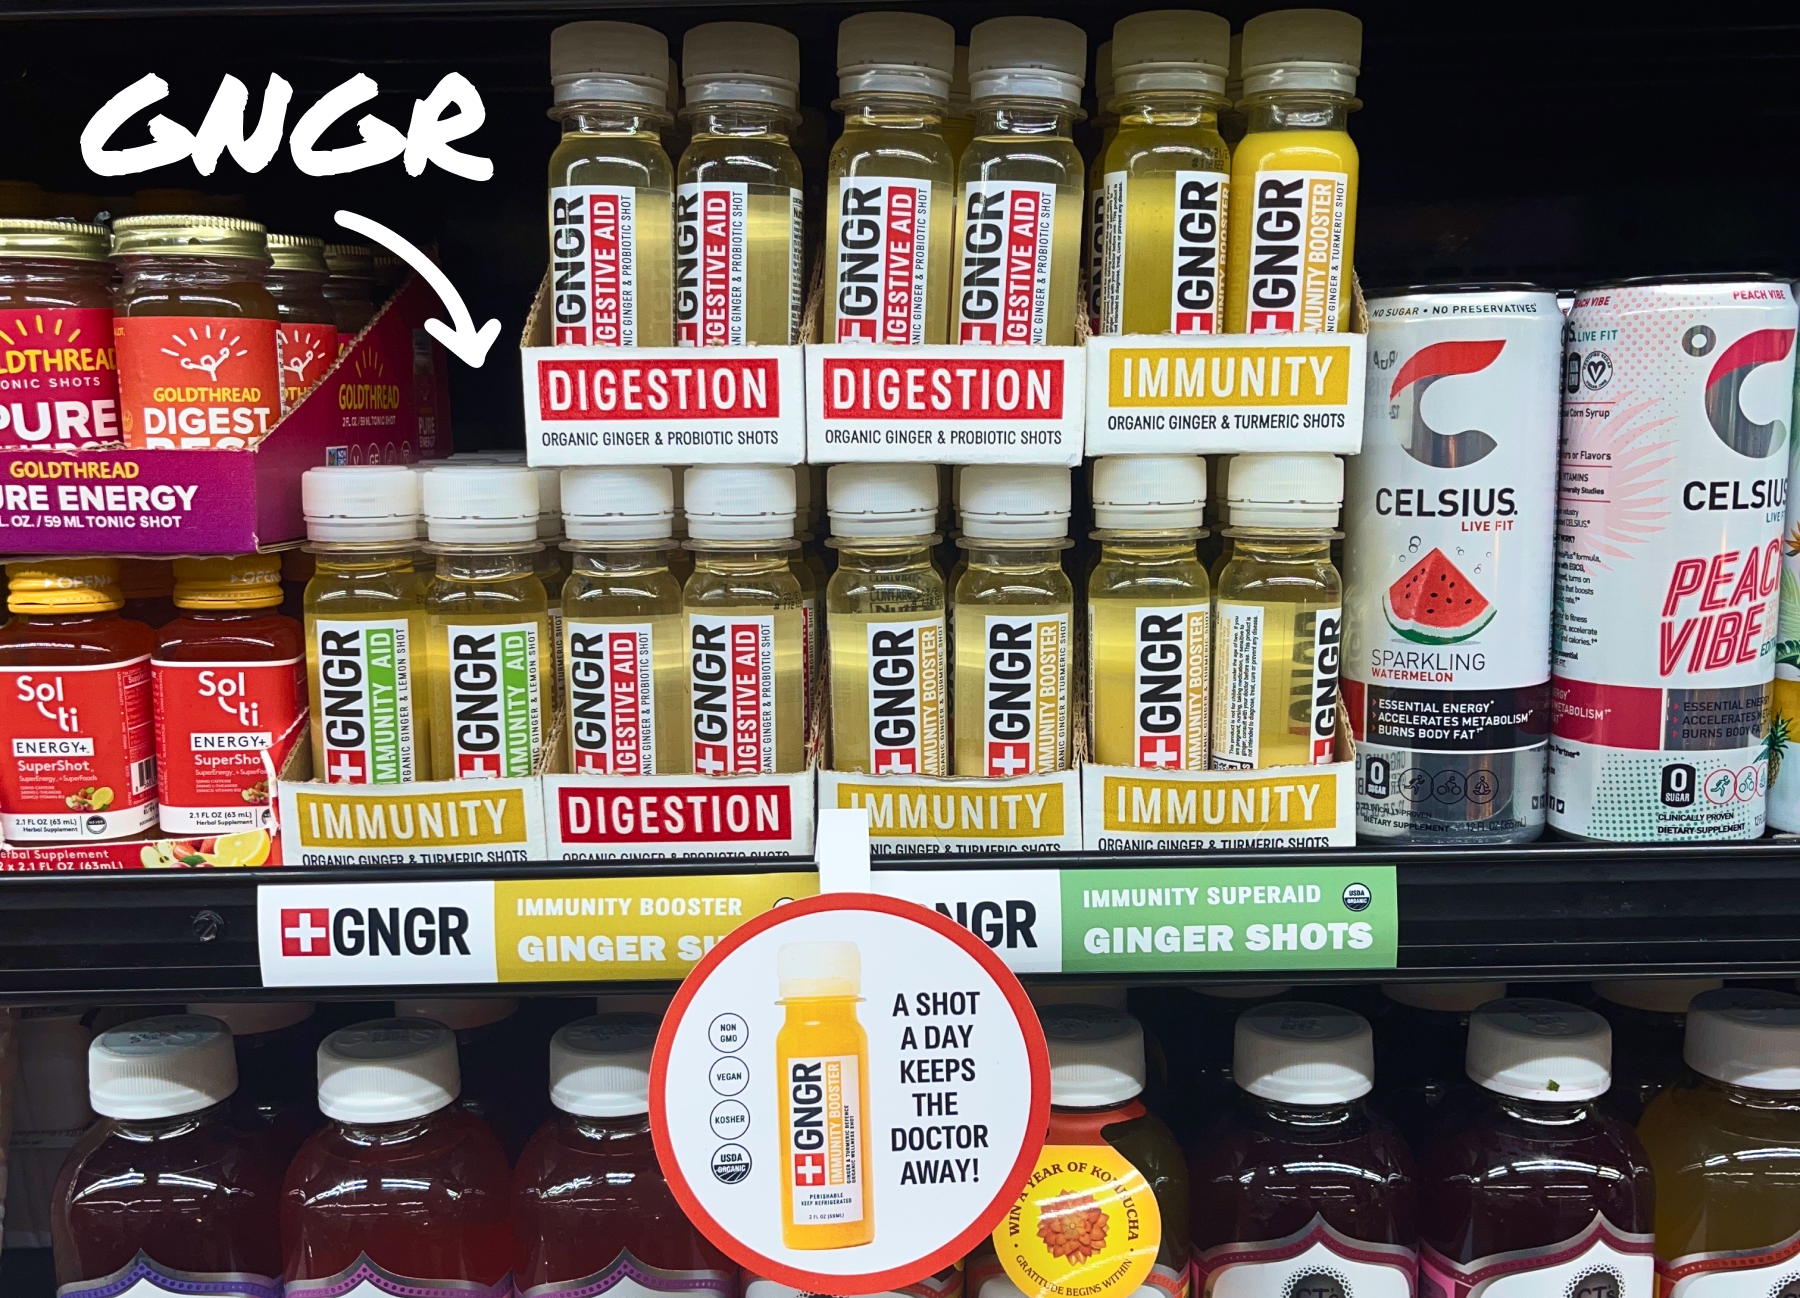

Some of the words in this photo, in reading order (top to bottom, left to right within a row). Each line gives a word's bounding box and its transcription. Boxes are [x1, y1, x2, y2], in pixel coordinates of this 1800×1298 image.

[890, 194, 912, 234] AID
[918, 188, 927, 216] SHOT
[1013, 197, 1036, 237] AID
[1309, 184, 1332, 262] BOOSTER
[839, 187, 882, 316] GNGR
[916, 218, 926, 272] PROBIOTIC
[961, 191, 1005, 320] GNGR
[1176, 180, 1219, 310] GNGR
[1252, 178, 1304, 309] GNGR
[554, 195, 586, 324] GNGR
[913, 284, 923, 324] GINGER
[1733, 290, 1767, 300] PEACH
[1768, 290, 1786, 299] VIBE
[1386, 308, 1419, 316] SUGAR
[1432, 306, 1448, 314] NO
[1577, 332, 1596, 342] LIVE
[1600, 330, 1618, 341] FIT
[49, 377, 100, 388] SHOTS
[548, 368, 767, 411] DIGESTION
[833, 368, 1051, 411] DIGESTION
[1123, 356, 1333, 398] IMMUNITY
[154, 387, 261, 402] GOLDTHREAD
[339, 384, 399, 410] GOLDTHREAD
[143, 407, 270, 434] DIGEST
[1108, 415, 1165, 430] ORGANIC
[1168, 415, 1217, 430] GINGER
[1221, 415, 1230, 429] &
[1234, 414, 1299, 429] TURMERIC
[1303, 413, 1345, 428] SHOTS
[1586, 408, 1610, 419] Syrup
[542, 432, 598, 447] ORGANIC
[603, 432, 650, 446] GINGER
[655, 432, 663, 445] &
[668, 431, 734, 446] PROBIOTIC
[738, 430, 778, 444] SHOTS
[825, 429, 882, 444] ORGANIC
[886, 430, 932, 444] GINGER
[938, 430, 946, 444] &
[950, 430, 1016, 445] PROBIOTIC
[1020, 430, 1062, 444] SHOTS
[1580, 451, 1611, 460] Flavors
[10, 461, 139, 479] GOLDTHREAD
[58, 485, 199, 510] ENERGY
[11, 516, 34, 527] OZ.
[44, 516, 61, 527] 59
[64, 516, 85, 527] ML
[85, 515, 136, 528] TONIC
[139, 515, 182, 528] SHOT
[1461, 522, 1490, 532] LIVE
[1495, 520, 1513, 531] FIT
[370, 633, 393, 668] AID
[396, 629, 406, 653] SHOT
[1659, 603, 1766, 677] VIBE
[922, 630, 936, 702] BOOSTER
[1140, 613, 1183, 733] GNGR
[1371, 649, 1486, 671] SPARKLING
[397, 658, 407, 691] LEMON
[693, 624, 728, 742] GNGR
[872, 628, 915, 746] GNGR
[988, 622, 1032, 740] GNGR
[1315, 617, 1341, 736] GNGR
[1371, 668, 1453, 682] WATERMELON
[321, 630, 365, 748] GNGR
[453, 633, 500, 752] GNGR
[571, 632, 607, 749] GNGR
[1378, 712, 1458, 726] ACCELERATES
[1379, 699, 1439, 713] ESSENTIAL
[1682, 712, 1756, 725] ACCELERATES
[1684, 701, 1743, 711] ESSENTIAL
[1379, 724, 1415, 738] BURNS
[1419, 727, 1450, 739] BODY
[1682, 728, 1722, 738] BURNS
[1726, 726, 1750, 737] BODY
[18, 760, 90, 774] SuperShot
[1371, 761, 1384, 783] 0
[1671, 768, 1687, 791] 0
[1117, 784, 1320, 824] IMMUNITY
[1666, 792, 1690, 802] SUGAR
[309, 798, 507, 839] IMMUNITY
[568, 794, 779, 835] DIGESTION
[1658, 826, 1695, 834] DIETARY
[1697, 823, 1745, 834] SUPPLEMENT
[34, 850, 109, 860] Supplement
[516, 898, 631, 917] IMMUNITY
[639, 897, 743, 917] BOOSTER
[1083, 887, 1199, 908] IMMUNITY
[1207, 885, 1321, 906] SUPERAID
[332, 906, 472, 957] GNGR
[1084, 926, 1234, 954] GINGER
[1244, 922, 1373, 951] SHOTS
[517, 935, 667, 963] GINGER
[892, 994, 910, 1017] A
[916, 991, 981, 1016] SHOT
[720, 1035, 737, 1043] GMO
[901, 1027, 918, 1050] A
[924, 1024, 974, 1049] DAY
[717, 1073, 742, 1081] VEGAN
[900, 1058, 976, 1084] KEEPS
[828, 1063, 840, 1118] BOOSTER
[792, 1062, 824, 1150] GNGR
[912, 1092, 959, 1117] THE
[715, 1115, 745, 1124] KOSHER
[891, 1124, 989, 1152] DOCTOR
[720, 1154, 743, 1163] USDA
[830, 1120, 842, 1183] IMMUNITY
[718, 1164, 746, 1173] ORGANIC
[900, 1158, 979, 1185] AWAY!
[1009, 1206, 1022, 1237] WIN
[1027, 1163, 1063, 1189] YEAR
[1067, 1162, 1088, 1172] OF
[1016, 1255, 1064, 1295] GRATITUDE
[1066, 1283, 1102, 1296] BEGINS
[1102, 1259, 1132, 1288] WITHIN
